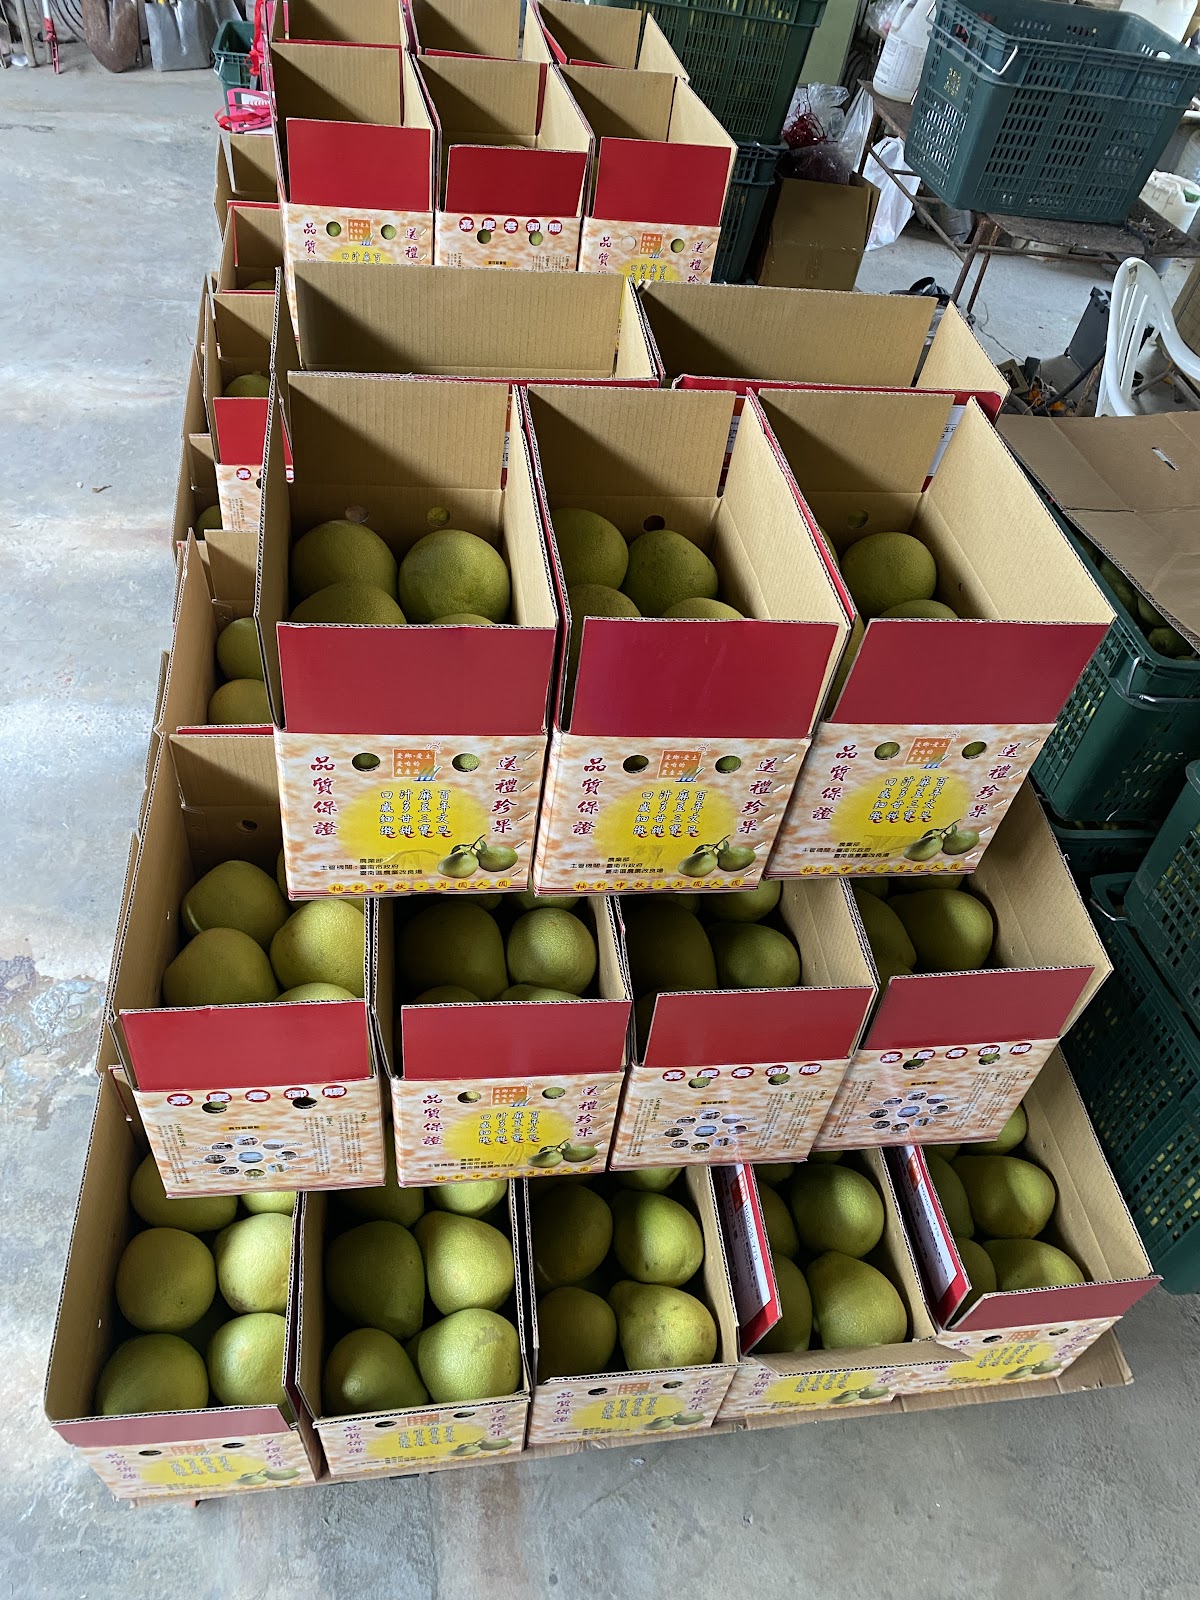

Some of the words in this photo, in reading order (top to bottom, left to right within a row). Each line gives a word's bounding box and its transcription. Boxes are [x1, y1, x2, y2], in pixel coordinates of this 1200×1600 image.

[310, 756, 339, 836] 品質保證
[491, 756, 521, 833] 送禮珍果
[572, 757, 607, 835] 品質保證
[738, 757, 779, 834] 送禮珍果
[812, 744, 858, 820] 品質保證
[968, 742, 1021, 818] 送禮珍果
[398, 789, 413, 835] 汁多甘甜
[418, 788, 432, 836] 麻豆三寶
[436, 789, 451, 834] 百年文旦
[650, 789, 672, 835] 汁多甘甜
[668, 788, 689, 836] 麻豆三寶
[684, 789, 708, 835] 百年文旦
